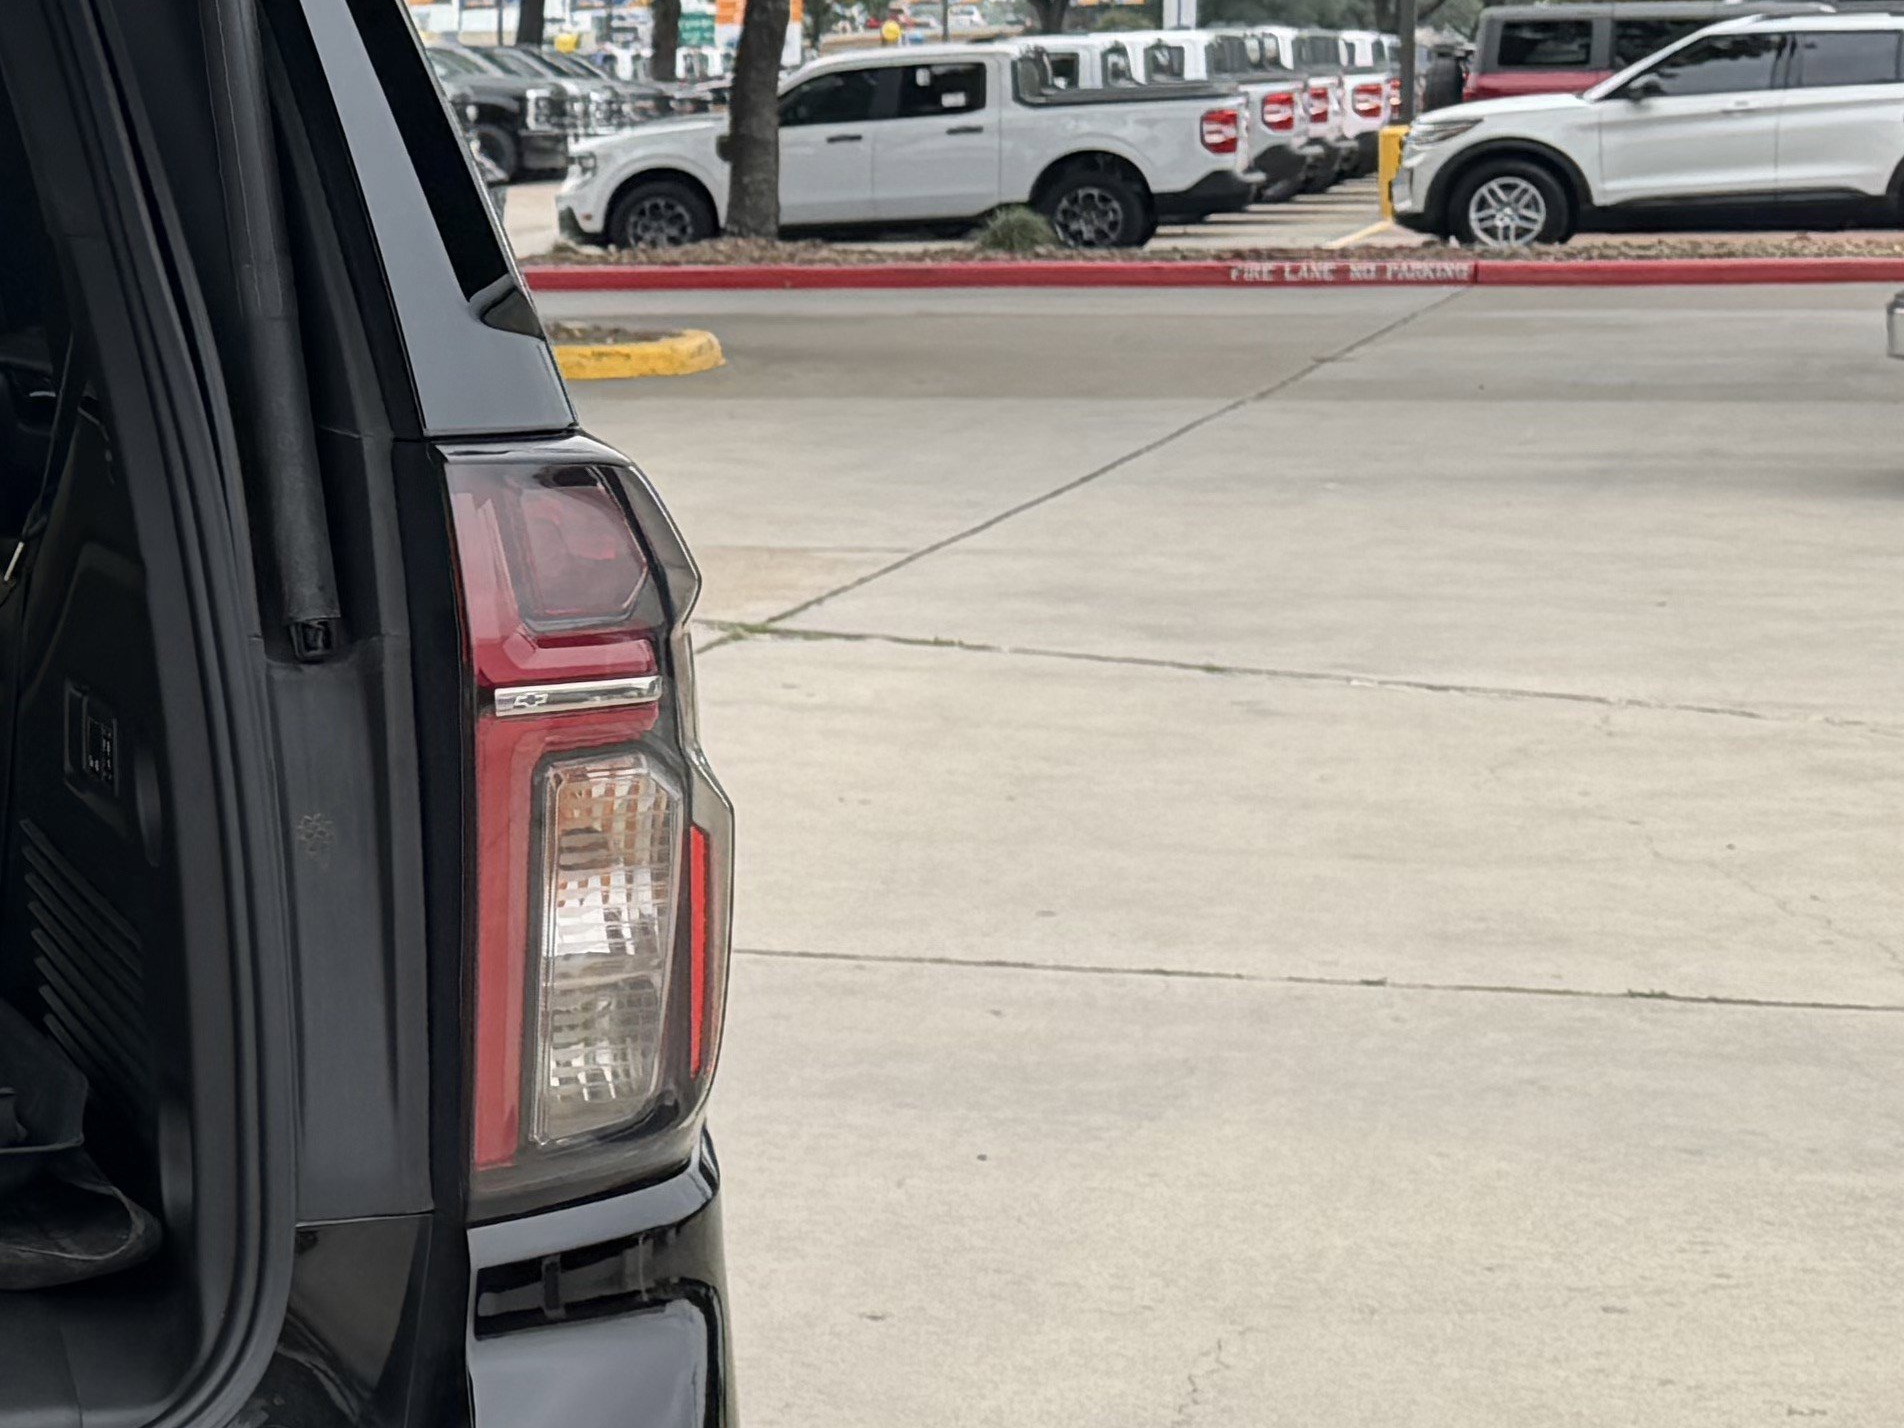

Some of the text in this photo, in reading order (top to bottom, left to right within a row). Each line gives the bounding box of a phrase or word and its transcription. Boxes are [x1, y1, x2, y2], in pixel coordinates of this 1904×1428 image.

[1230, 259, 1470, 281] FIRE LANE NO PARKING
